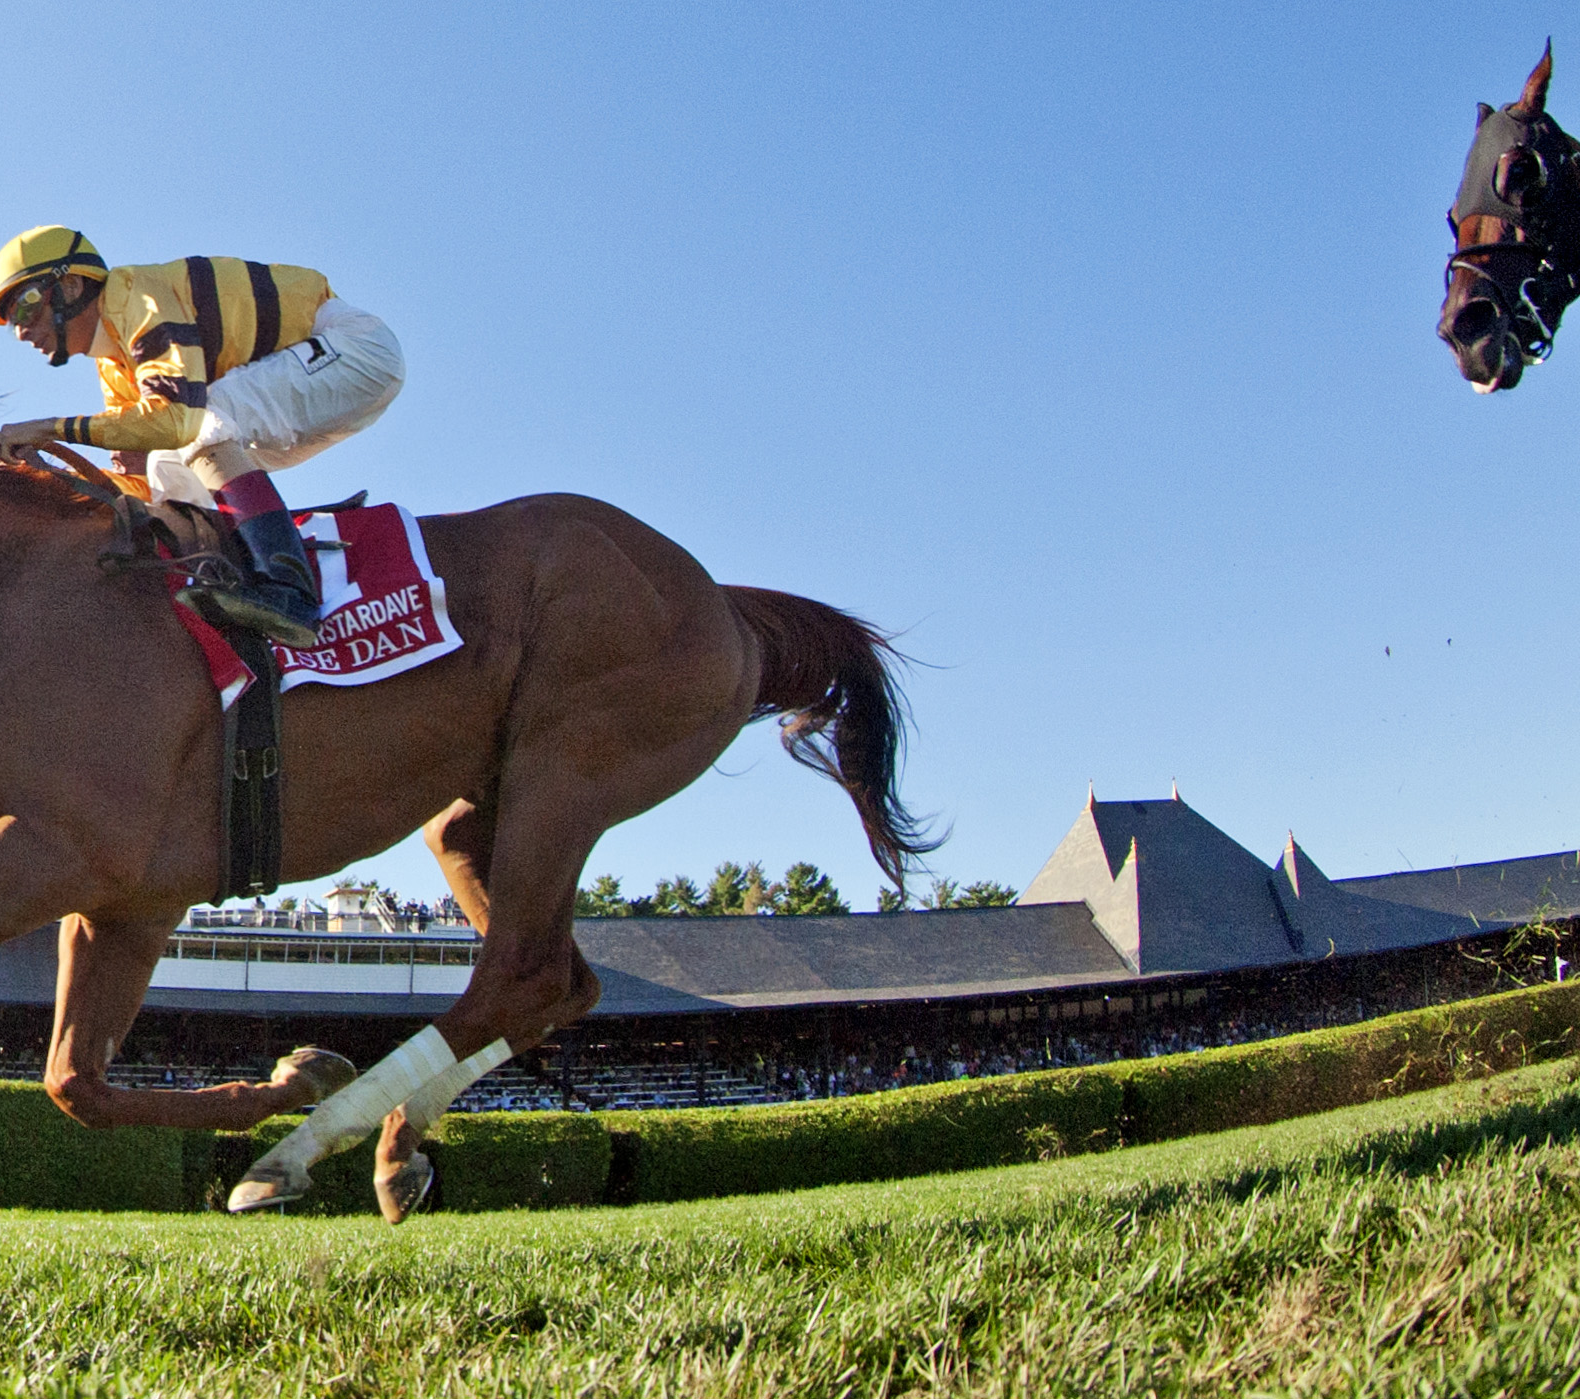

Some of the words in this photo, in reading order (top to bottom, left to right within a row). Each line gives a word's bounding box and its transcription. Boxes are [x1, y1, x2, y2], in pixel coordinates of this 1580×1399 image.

[298, 512, 363, 620] 1
[271, 645, 341, 671] ISE
[345, 616, 427, 667] DAN
